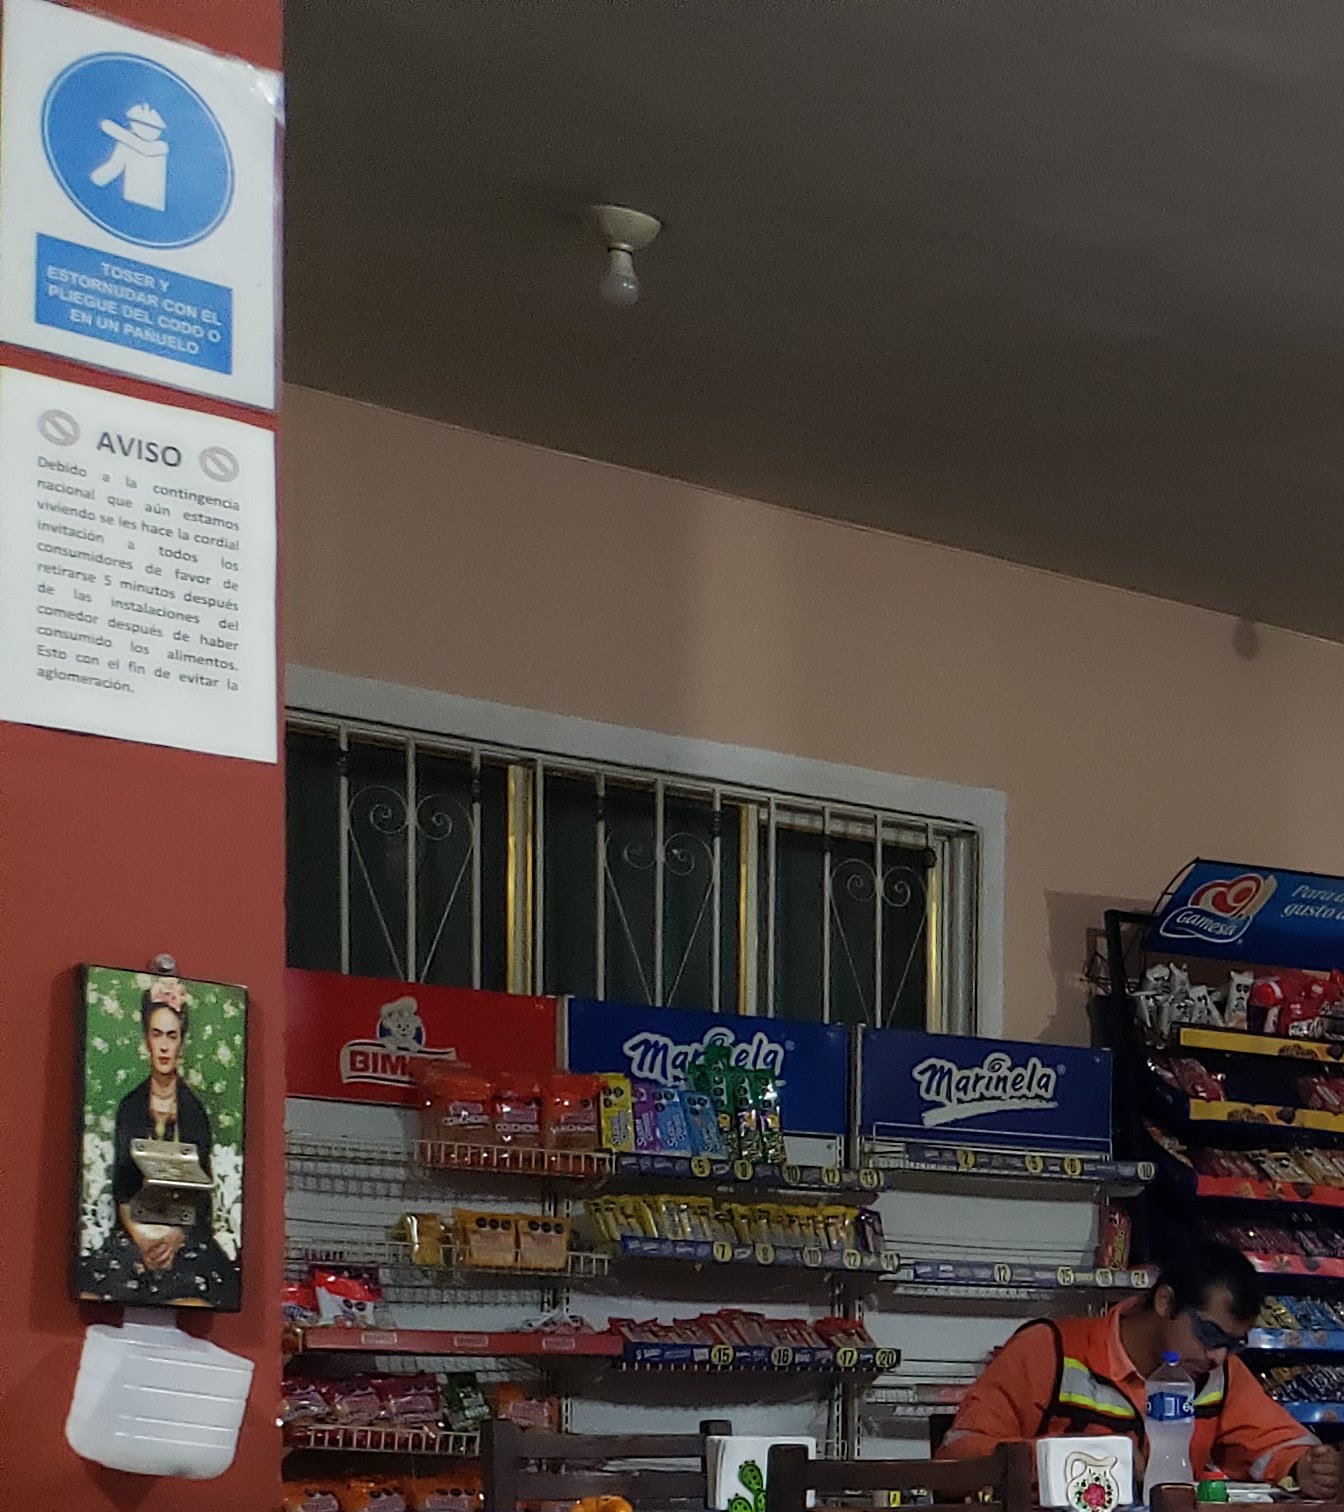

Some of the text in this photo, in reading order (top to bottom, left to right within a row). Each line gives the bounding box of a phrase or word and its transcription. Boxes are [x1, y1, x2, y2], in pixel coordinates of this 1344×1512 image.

[46, 265, 223, 327] ESTORNUDAR CON EL
[101, 262, 170, 294] TOSER Y
[47, 284, 222, 344] PLIEGUE DEL CODO O
[69, 307, 200, 356] EN UN PAÑUELO
[96, 431, 184, 469] AVISO
[37, 455, 241, 512] Debido a la contingencia
[37, 478, 240, 533] nacional que aún estamos
[37, 499, 240, 552] viviendo se les hace la cordial
[37, 519, 240, 573] invitación a todos los
[37, 540, 240, 593] consumidores de favor de
[37, 562, 240, 613] retirarse 5 minutos después
[37, 582, 240, 633] de las instalaciones del
[37, 603, 240, 653] comedor después de haber
[37, 624, 240, 673] consumido los alimentos.
[37, 643, 240, 693] Esto con el fin de evitar la
[37, 665, 136, 695] aglomeración.
[1281, 901, 1334, 919] gusto
[1291, 884, 1334, 901] Para
[1175, 910, 1239, 937] Gamesa
[350, 1049, 414, 1077] BIM
[913, 1054, 1054, 1103] Marinela
